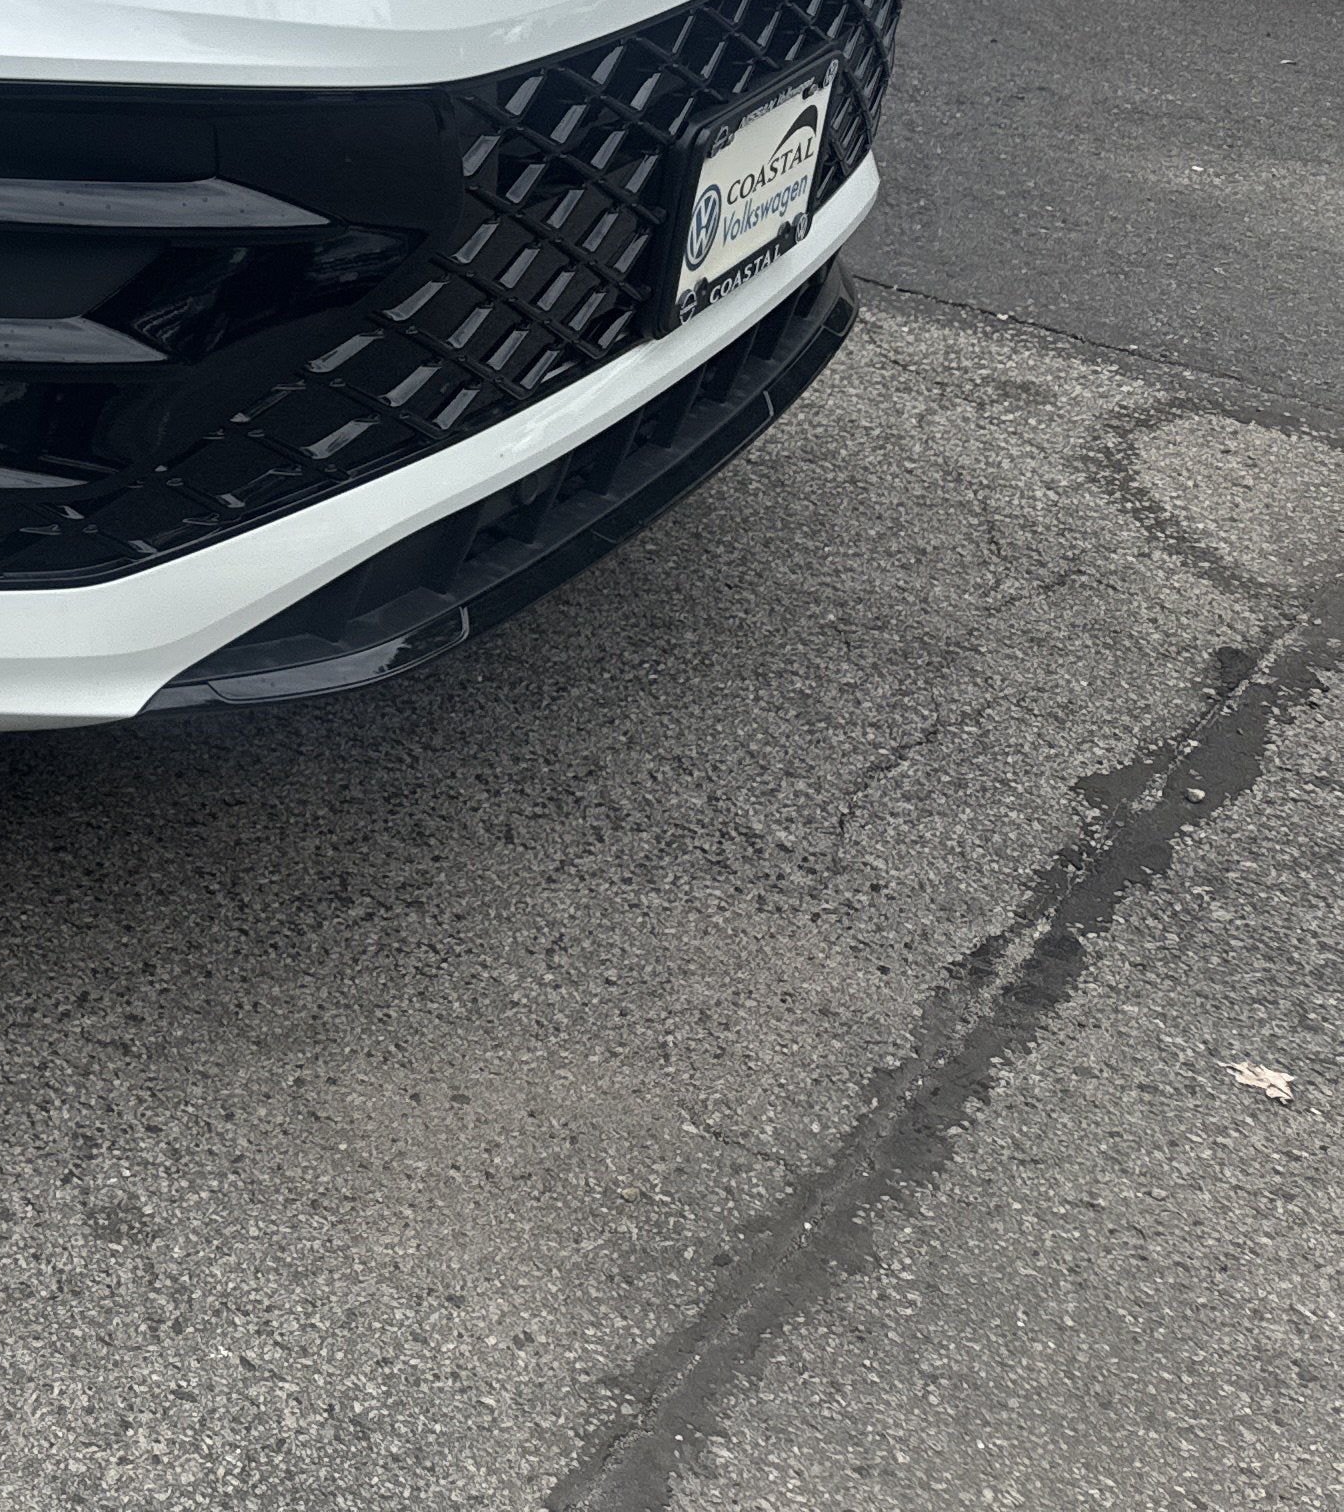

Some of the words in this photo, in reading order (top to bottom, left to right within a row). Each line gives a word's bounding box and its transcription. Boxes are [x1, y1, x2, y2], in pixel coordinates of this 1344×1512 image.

[726, 136, 815, 206] COASTAL
[684, 183, 723, 272] VW
[722, 174, 809, 248] Volkswagen
[708, 243, 782, 305] COASTAL
